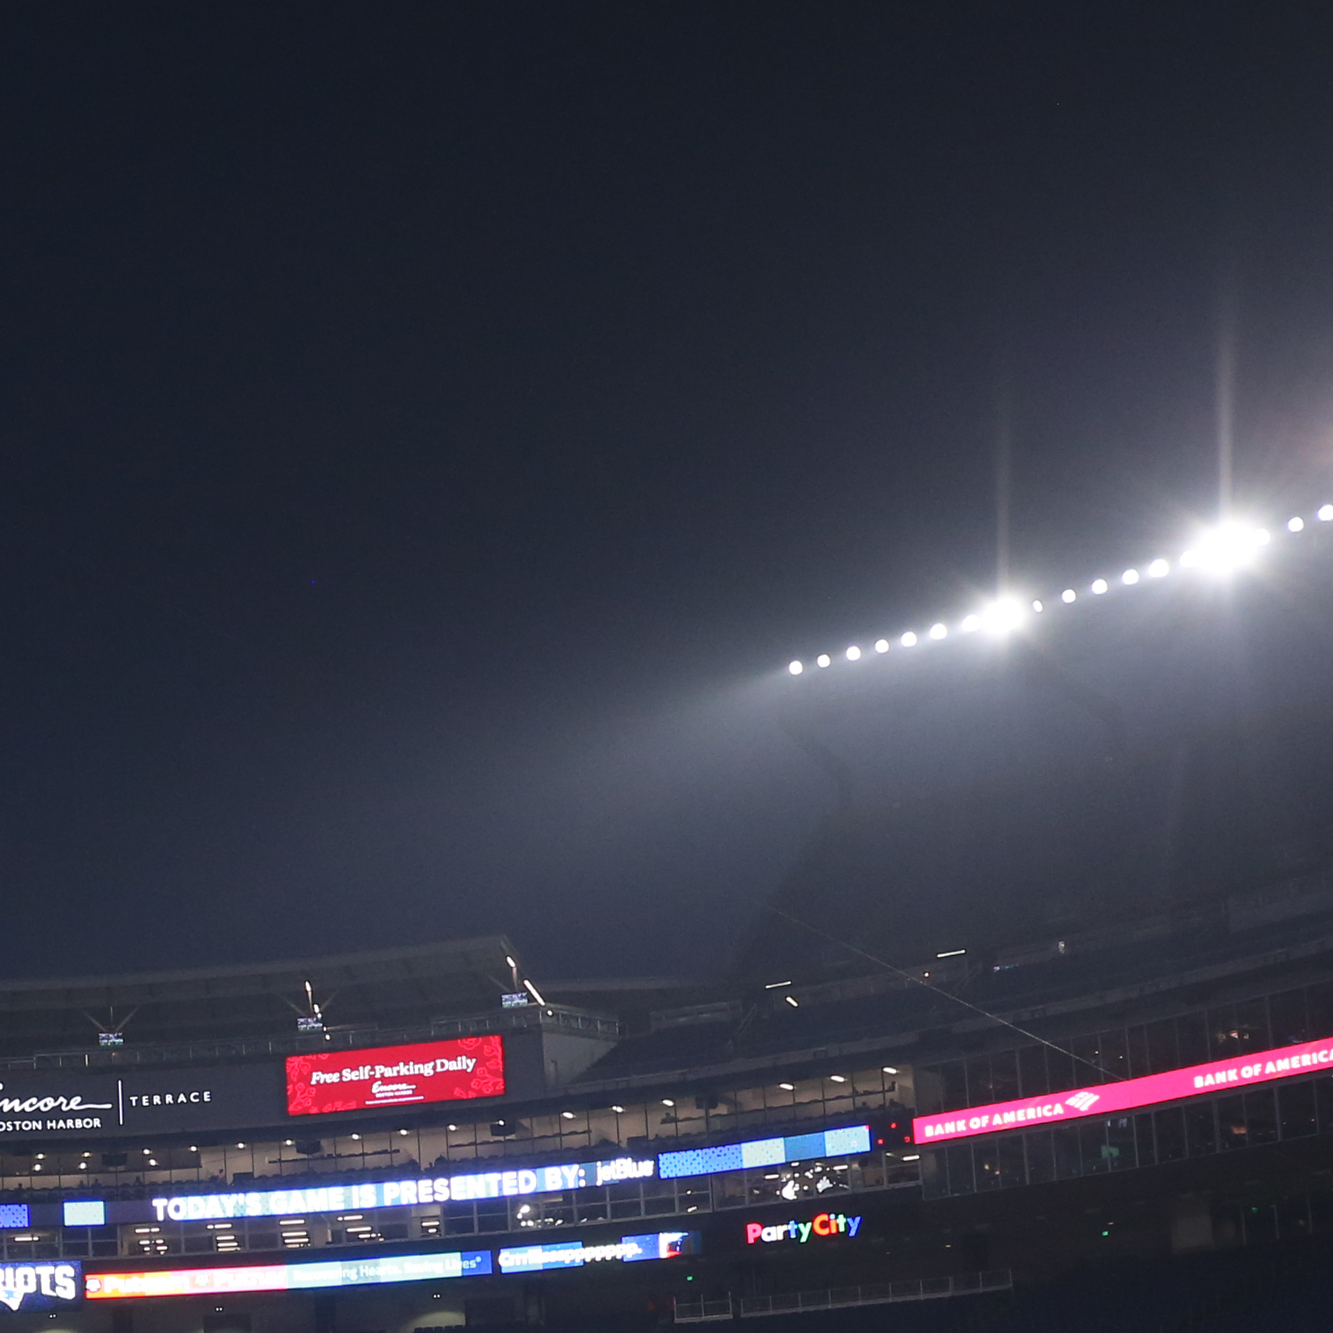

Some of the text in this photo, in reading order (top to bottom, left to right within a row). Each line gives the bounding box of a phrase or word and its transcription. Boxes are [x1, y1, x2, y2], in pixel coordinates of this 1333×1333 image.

[310, 1055, 477, 1085] Free Self-Parking Daily
[1194, 1067, 1238, 1088] BANK
[1241, 1062, 1263, 1079] OF
[130, 1090, 212, 1107] TERRACE
[47, 1117, 102, 1130] HARBOR
[924, 1101, 1064, 1137] BANK OF AMERICA
[152, 1193, 261, 1221] TODAY'S
[270, 1186, 348, 1213] GAME
[351, 1183, 376, 1209] IS
[383, 1167, 536, 1204] PRESENTED
[545, 1165, 586, 1190] BY:
